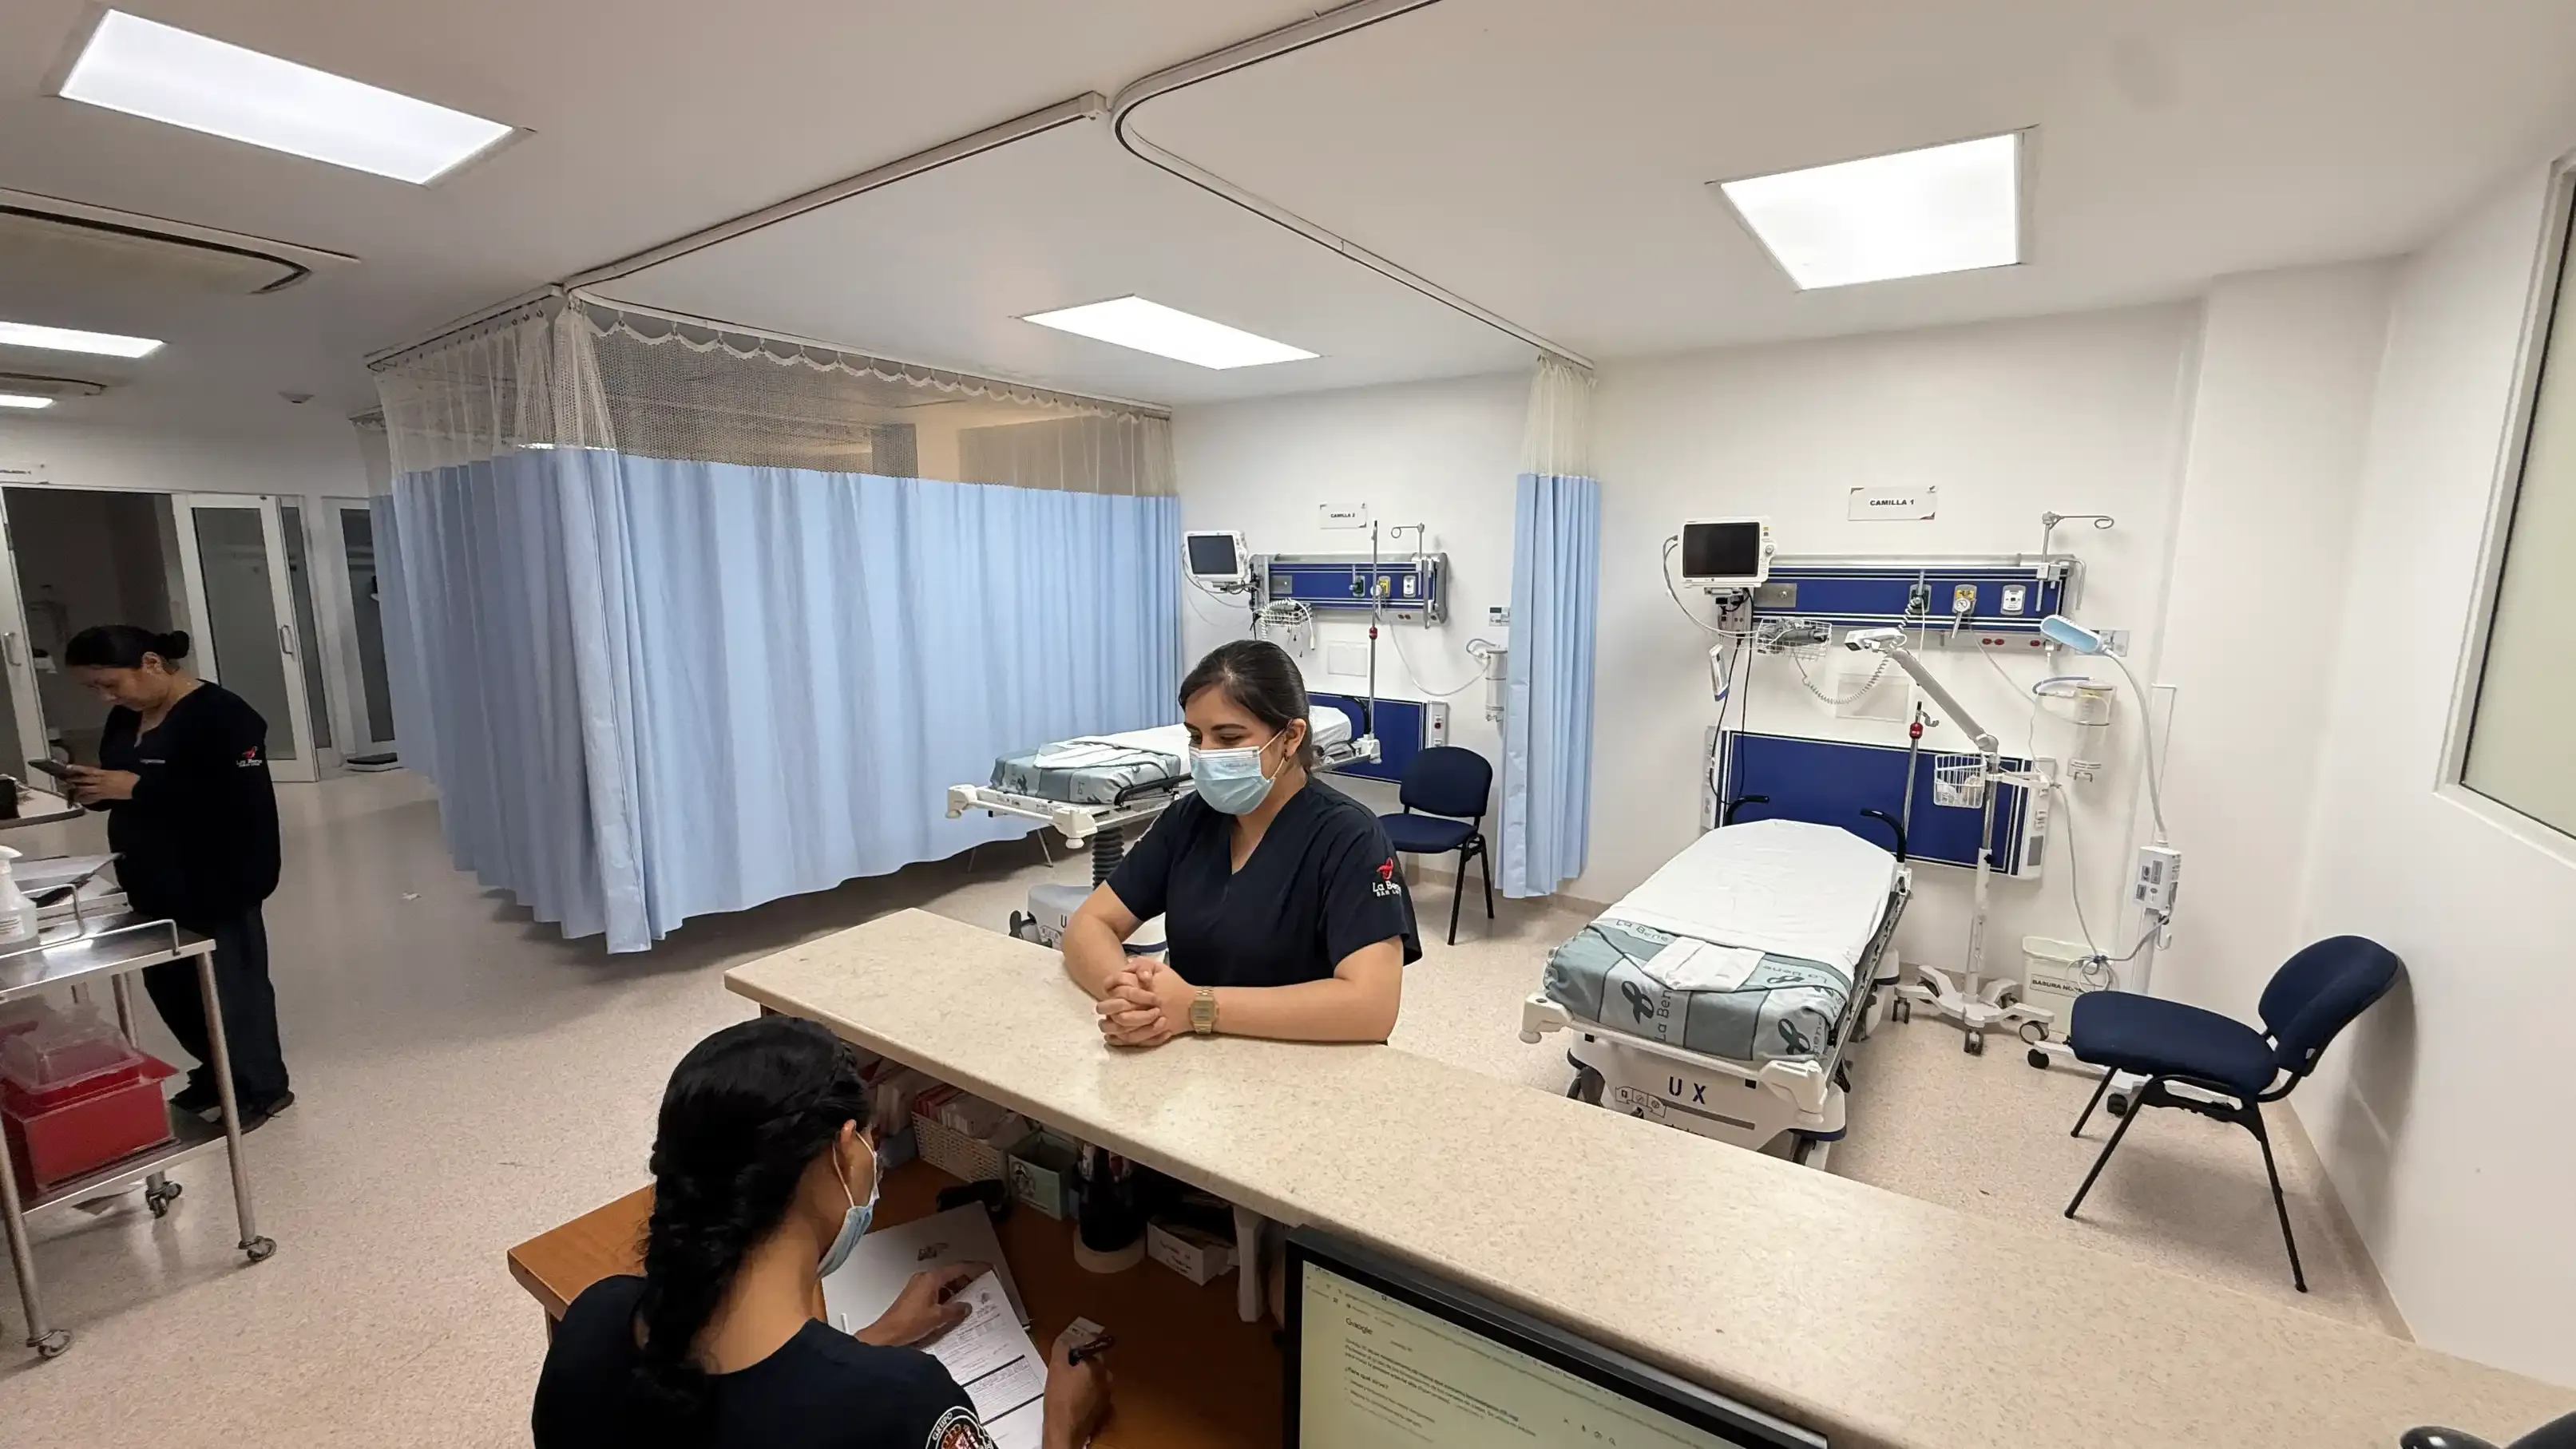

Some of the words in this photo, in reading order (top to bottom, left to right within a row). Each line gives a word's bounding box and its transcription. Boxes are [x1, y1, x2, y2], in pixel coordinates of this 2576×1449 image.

[1372, 881, 1385, 893] La
[1615, 919, 1633, 928] La
[1635, 925, 1669, 942] Bene
[2032, 980, 2062, 989] BASURA
[1656, 990, 1672, 1019] Ben
[1655, 1023, 1667, 1042] La
[1345, 1317, 1373, 1335] Google
[932, 1411, 953, 1440] GRUPO
